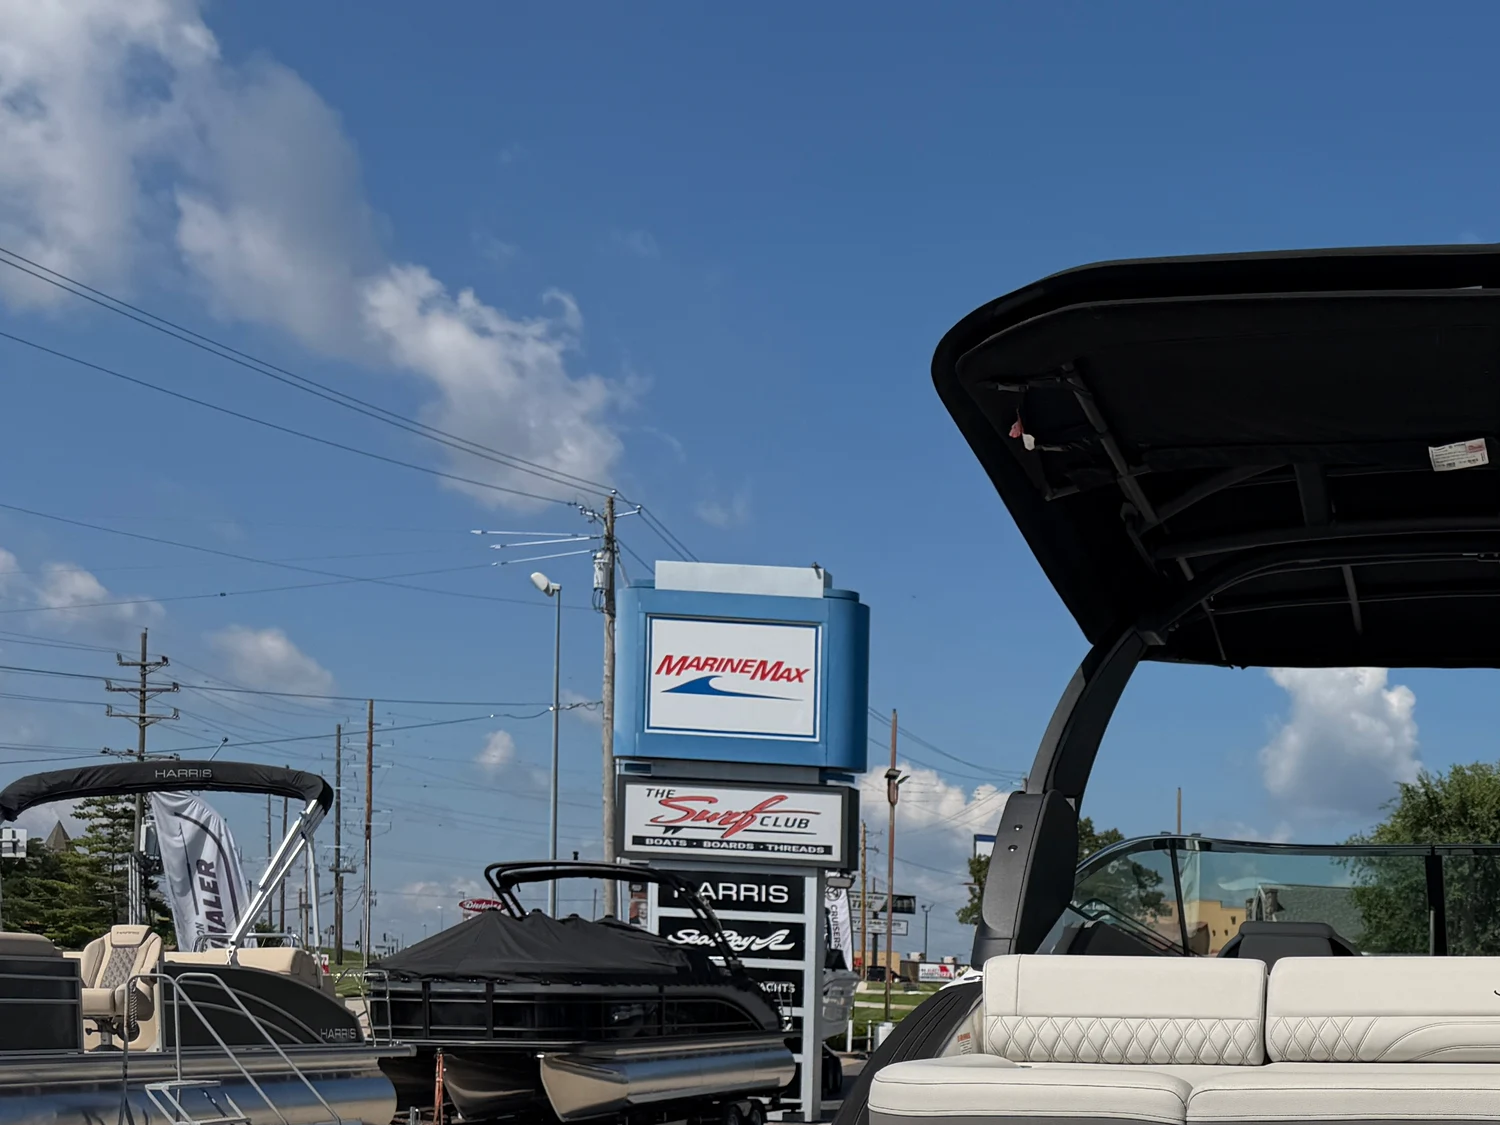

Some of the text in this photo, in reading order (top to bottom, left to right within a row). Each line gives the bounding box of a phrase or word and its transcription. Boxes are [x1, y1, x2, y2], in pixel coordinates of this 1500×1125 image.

[155, 768, 212, 778] HARRIS
[645, 788, 676, 799] THE
[650, 795, 821, 838] Surf
[759, 815, 810, 829] CLUB
[645, 838, 825, 854] BOATS BOARDS THREADS
[830, 904, 842, 949] CRUISERS
[320, 1028, 357, 1039] HARRIS
